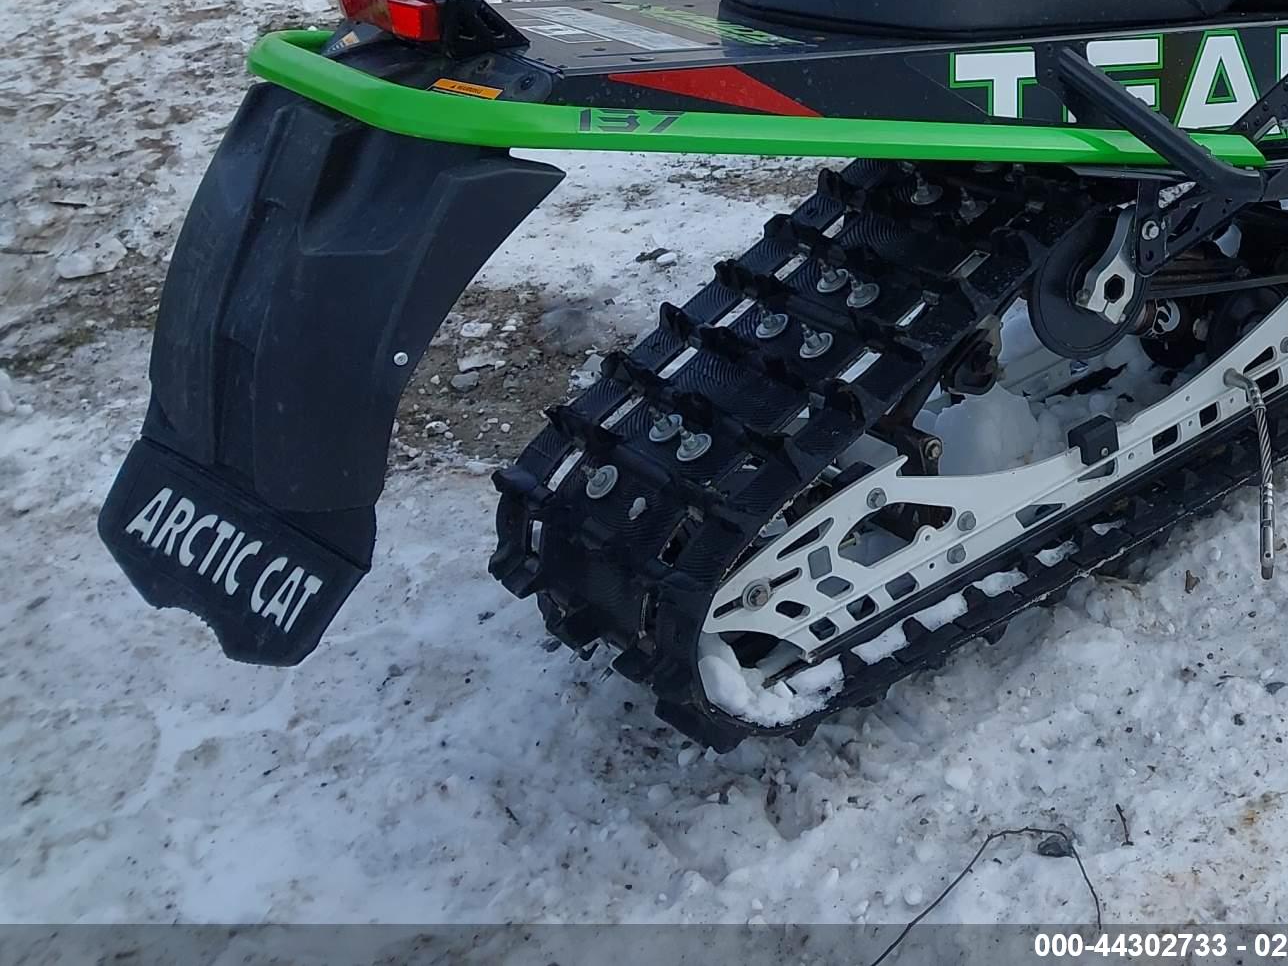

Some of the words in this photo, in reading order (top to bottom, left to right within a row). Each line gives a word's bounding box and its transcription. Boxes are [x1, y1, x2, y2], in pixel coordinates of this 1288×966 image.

[578, 108, 687, 134] 137
[125, 487, 263, 596] ARCTIC
[250, 556, 323, 634] CAT
